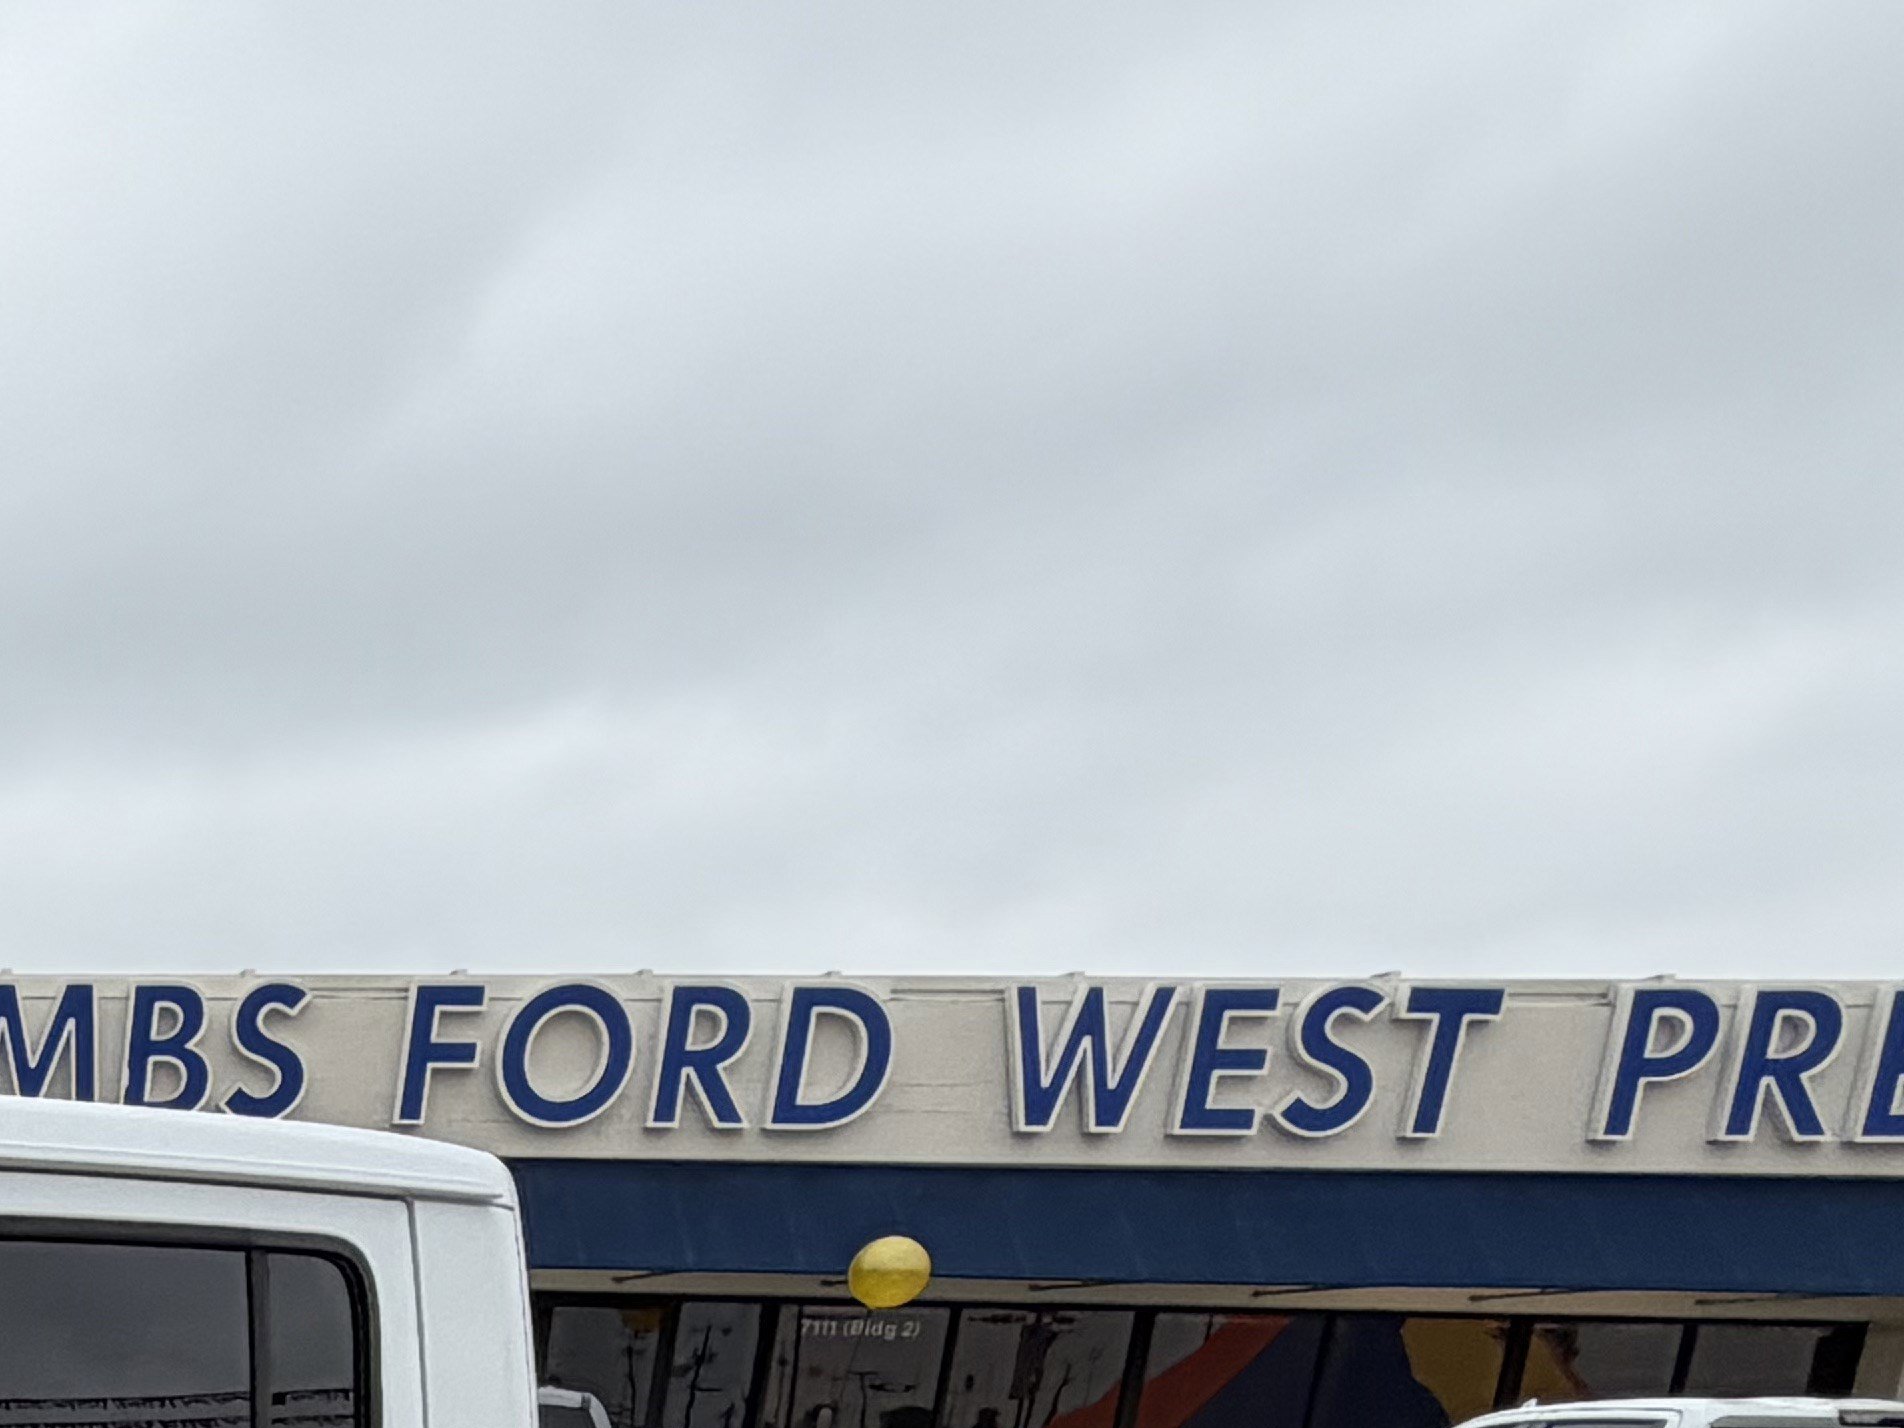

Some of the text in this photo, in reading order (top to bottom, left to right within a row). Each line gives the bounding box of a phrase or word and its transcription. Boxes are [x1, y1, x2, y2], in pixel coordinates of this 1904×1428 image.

[402, 985, 892, 1125] FORD
[1020, 988, 1503, 1134] WEST
[801, 1319, 920, 1340] 7111 (Bldg 2)
